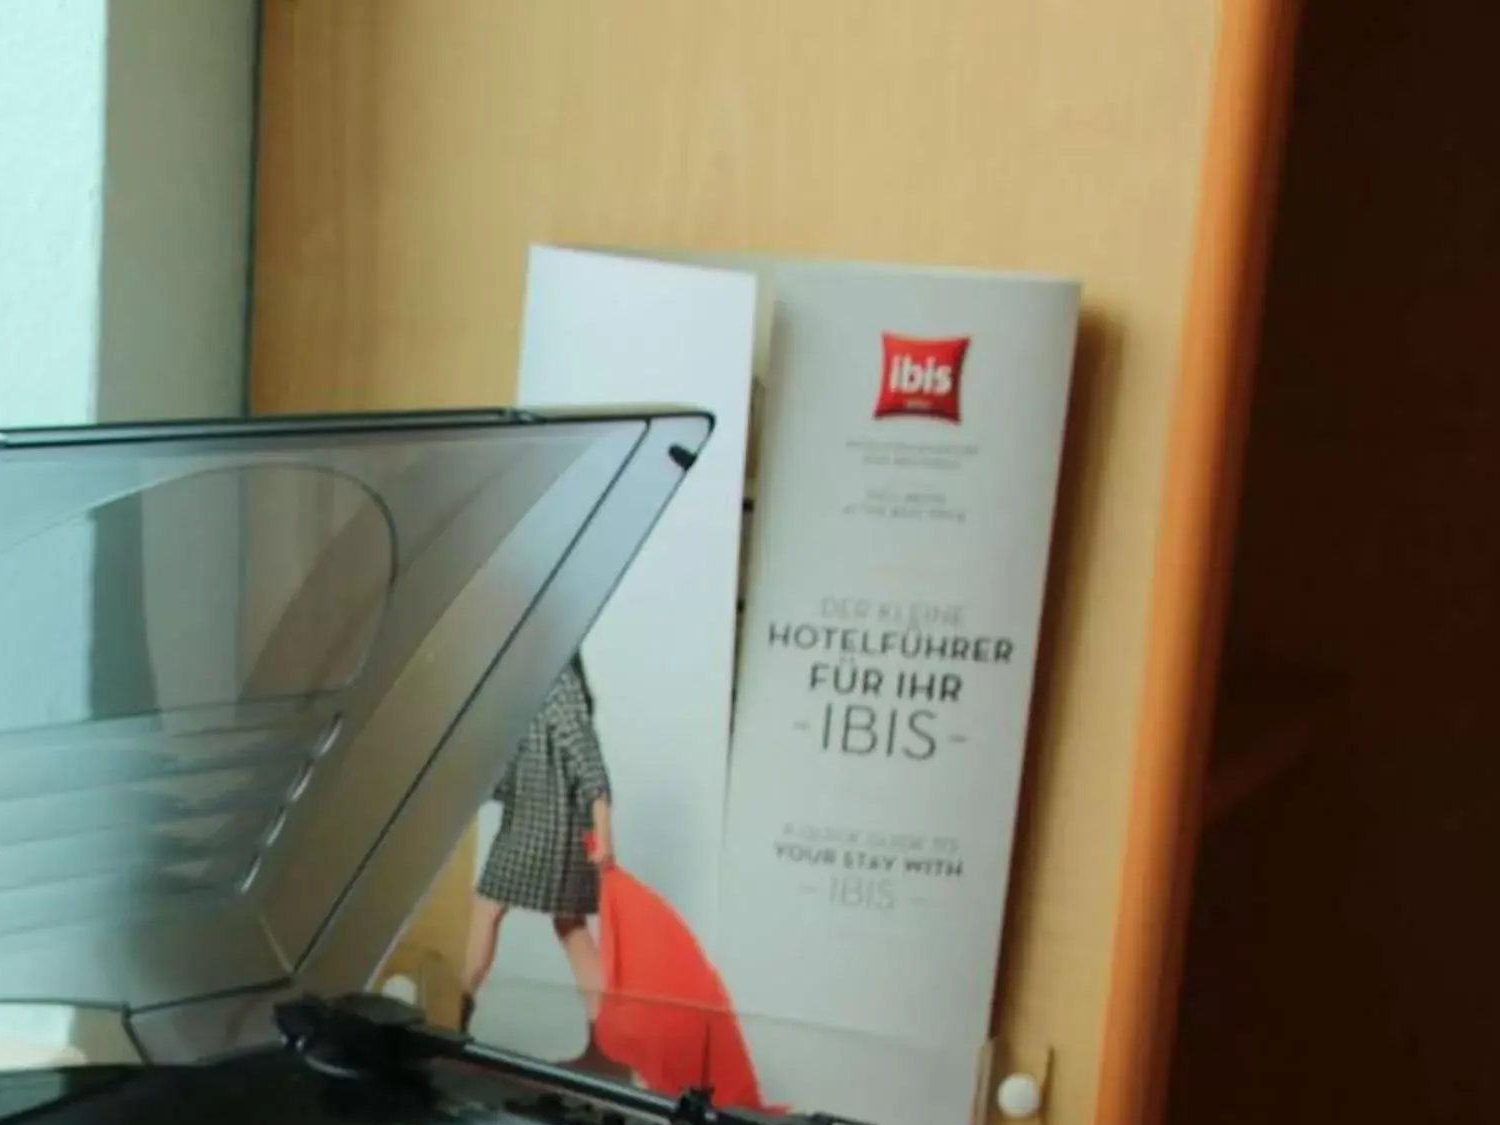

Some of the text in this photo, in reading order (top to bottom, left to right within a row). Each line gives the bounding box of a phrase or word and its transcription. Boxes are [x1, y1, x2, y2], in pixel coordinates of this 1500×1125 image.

[890, 352, 953, 396] ibis
[768, 620, 1015, 664] HOTELFÜHRER
[809, 654, 963, 702] FÜR IHR
